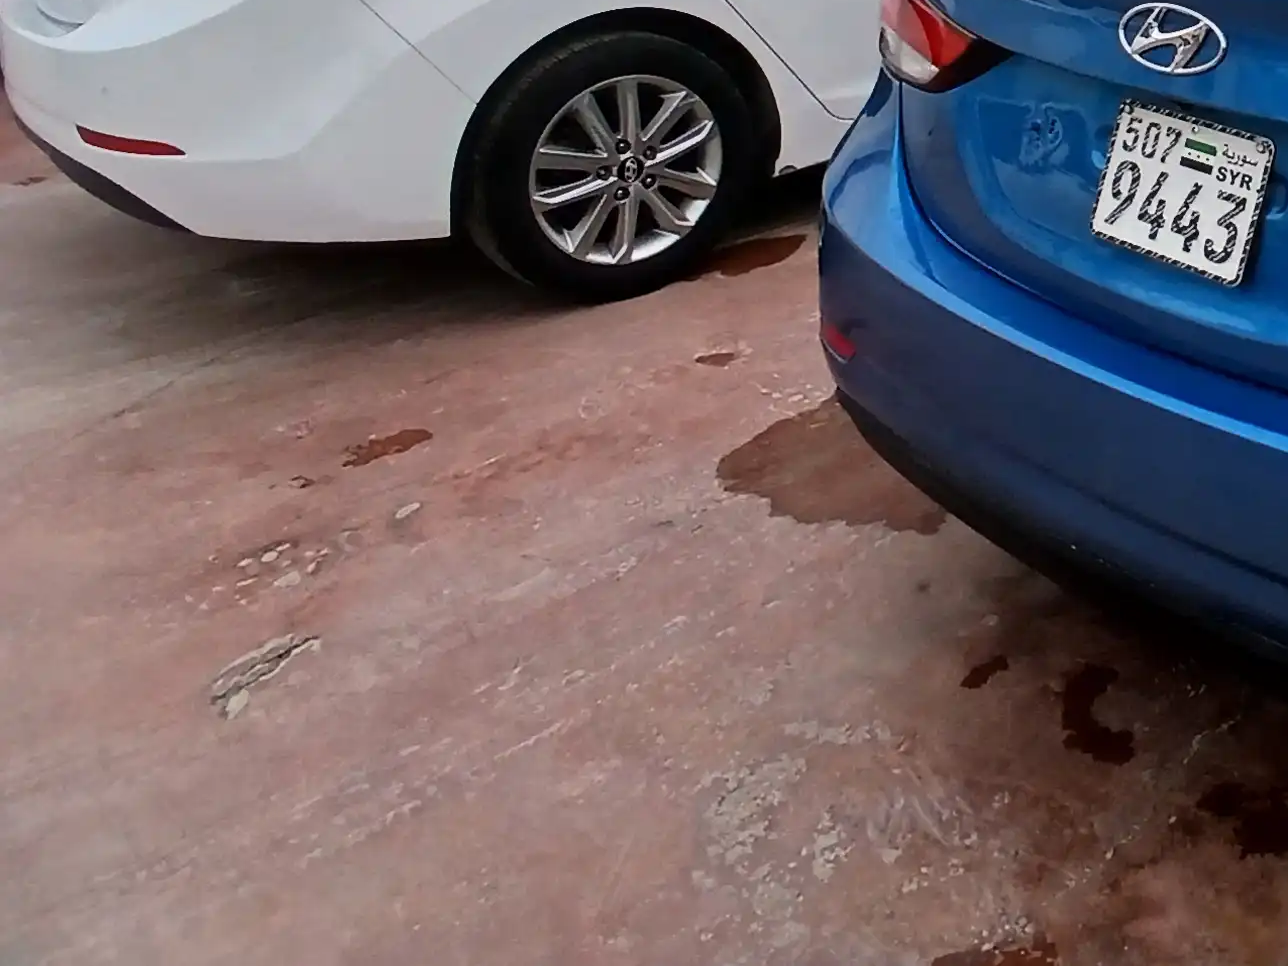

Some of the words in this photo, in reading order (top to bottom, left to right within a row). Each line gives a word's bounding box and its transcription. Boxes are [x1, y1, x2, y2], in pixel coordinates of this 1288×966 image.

[1122, 116, 1182, 163] 507
[1221, 143, 1259, 167] سورية
[1215, 166, 1253, 191] SYR
[1104, 160, 1247, 264] 9443
